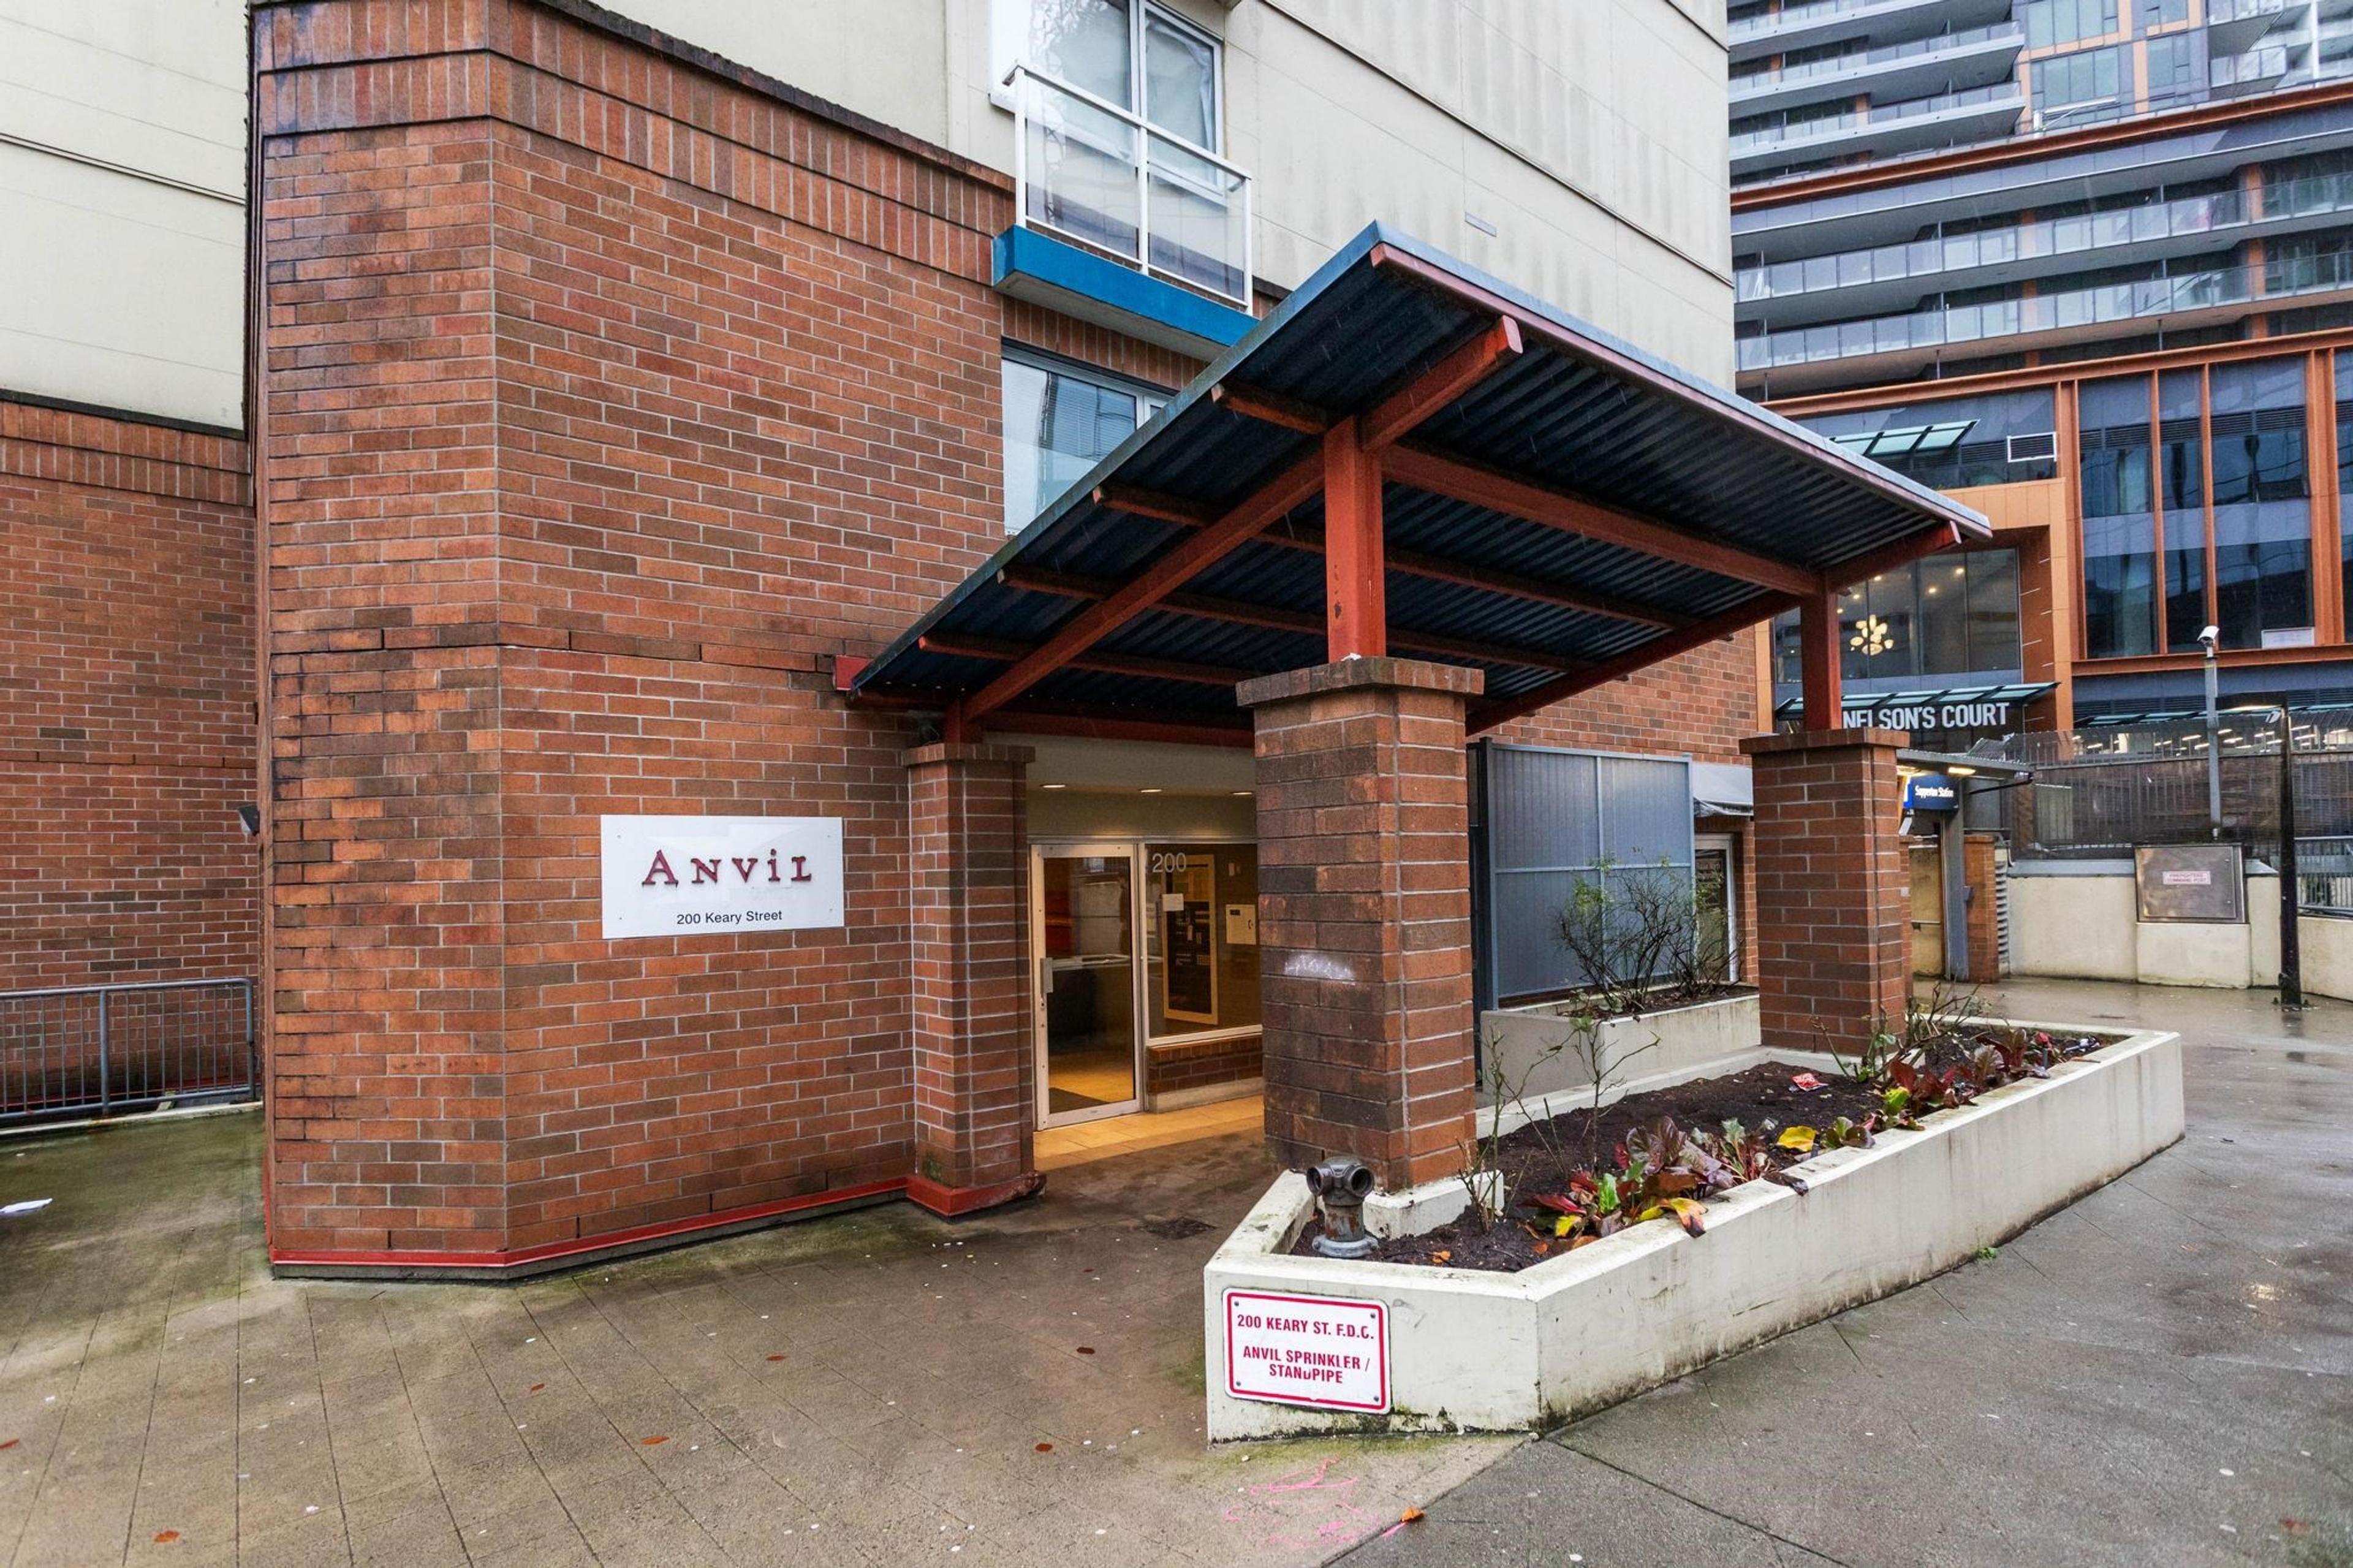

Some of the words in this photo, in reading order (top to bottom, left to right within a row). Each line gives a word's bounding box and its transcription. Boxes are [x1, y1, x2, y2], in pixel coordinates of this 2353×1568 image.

[1941, 702, 2010, 728] COURT
[1152, 852, 1186, 873] 200
[676, 913, 701, 925] 200
[705, 912, 742, 925] Keary
[746, 910, 782, 921] Street
[1237, 1314, 1261, 1328] 200
[1266, 1317, 1308, 1333] KEARY
[1313, 1321, 1331, 1335] ST.
[1336, 1324, 1374, 1339] F.D.C.
[1243, 1346, 1281, 1361] ANVIL
[1286, 1350, 1360, 1369] SPRINKLER
[1269, 1363, 1343, 1384] STANDPIPE
